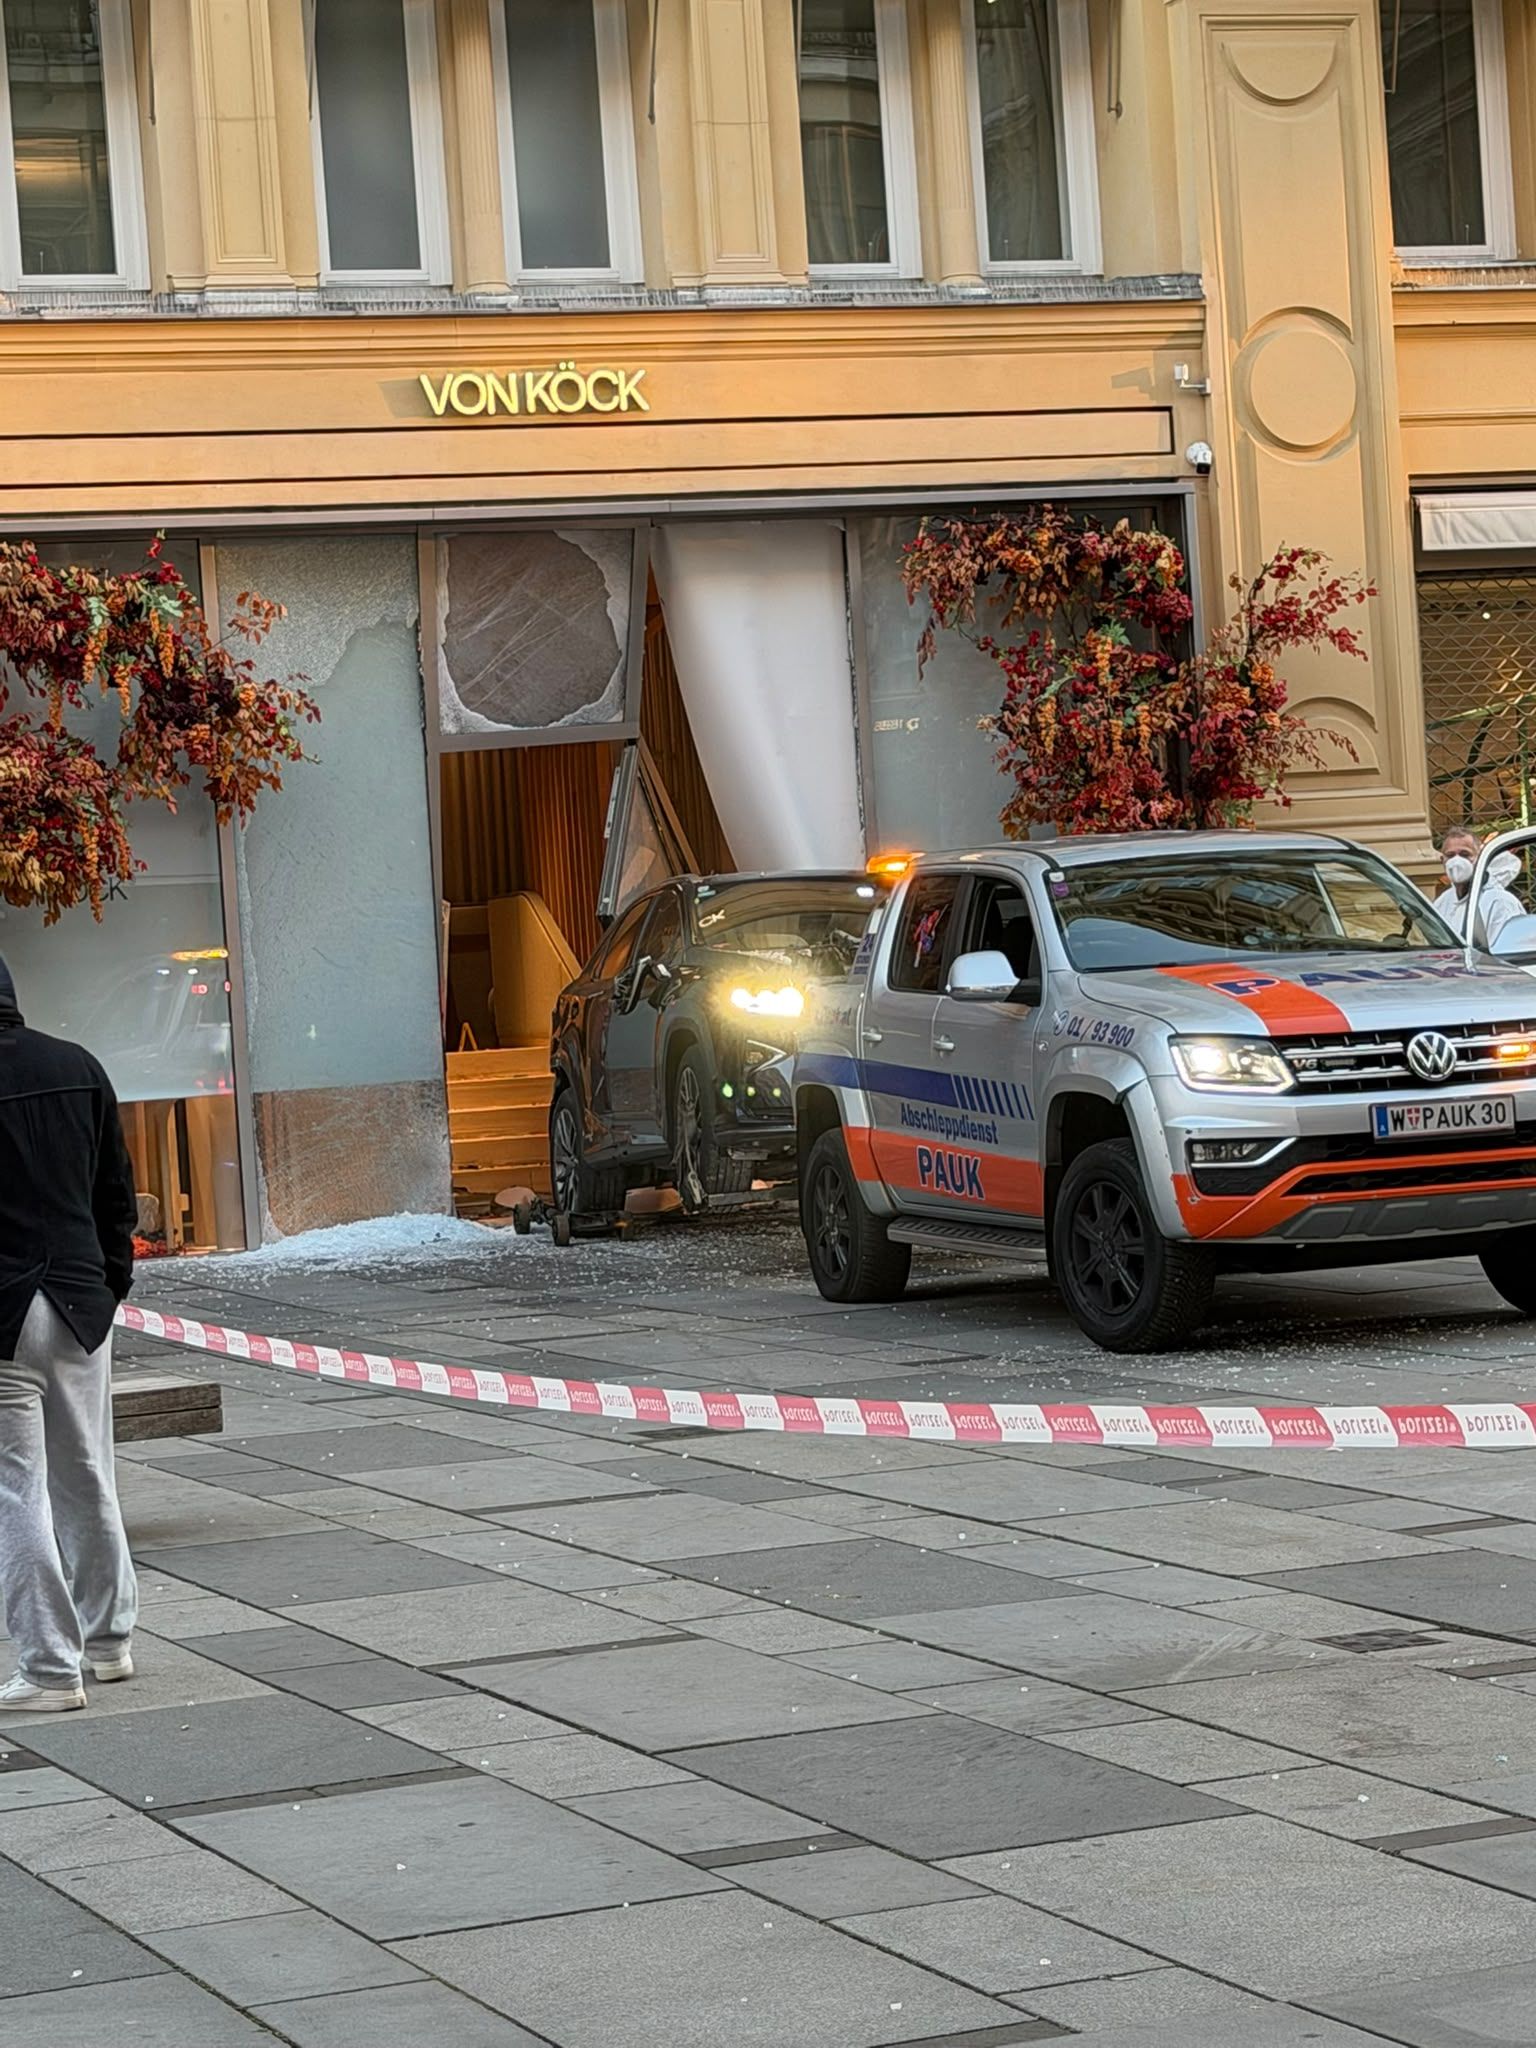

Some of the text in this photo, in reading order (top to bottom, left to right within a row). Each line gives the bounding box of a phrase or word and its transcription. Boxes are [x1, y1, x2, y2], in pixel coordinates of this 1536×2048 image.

[418, 360, 650, 416] VON KÖCK
[1067, 1016, 1084, 1037] 01
[1091, 1021, 1110, 1042] 93
[1108, 1024, 1135, 1047] 900
[1292, 1058, 1318, 1070] V6
[901, 1102, 999, 1145] Abschleppdienst
[1390, 1102, 1506, 1131] W PAUK 30
[916, 1145, 986, 1201] PAUK
